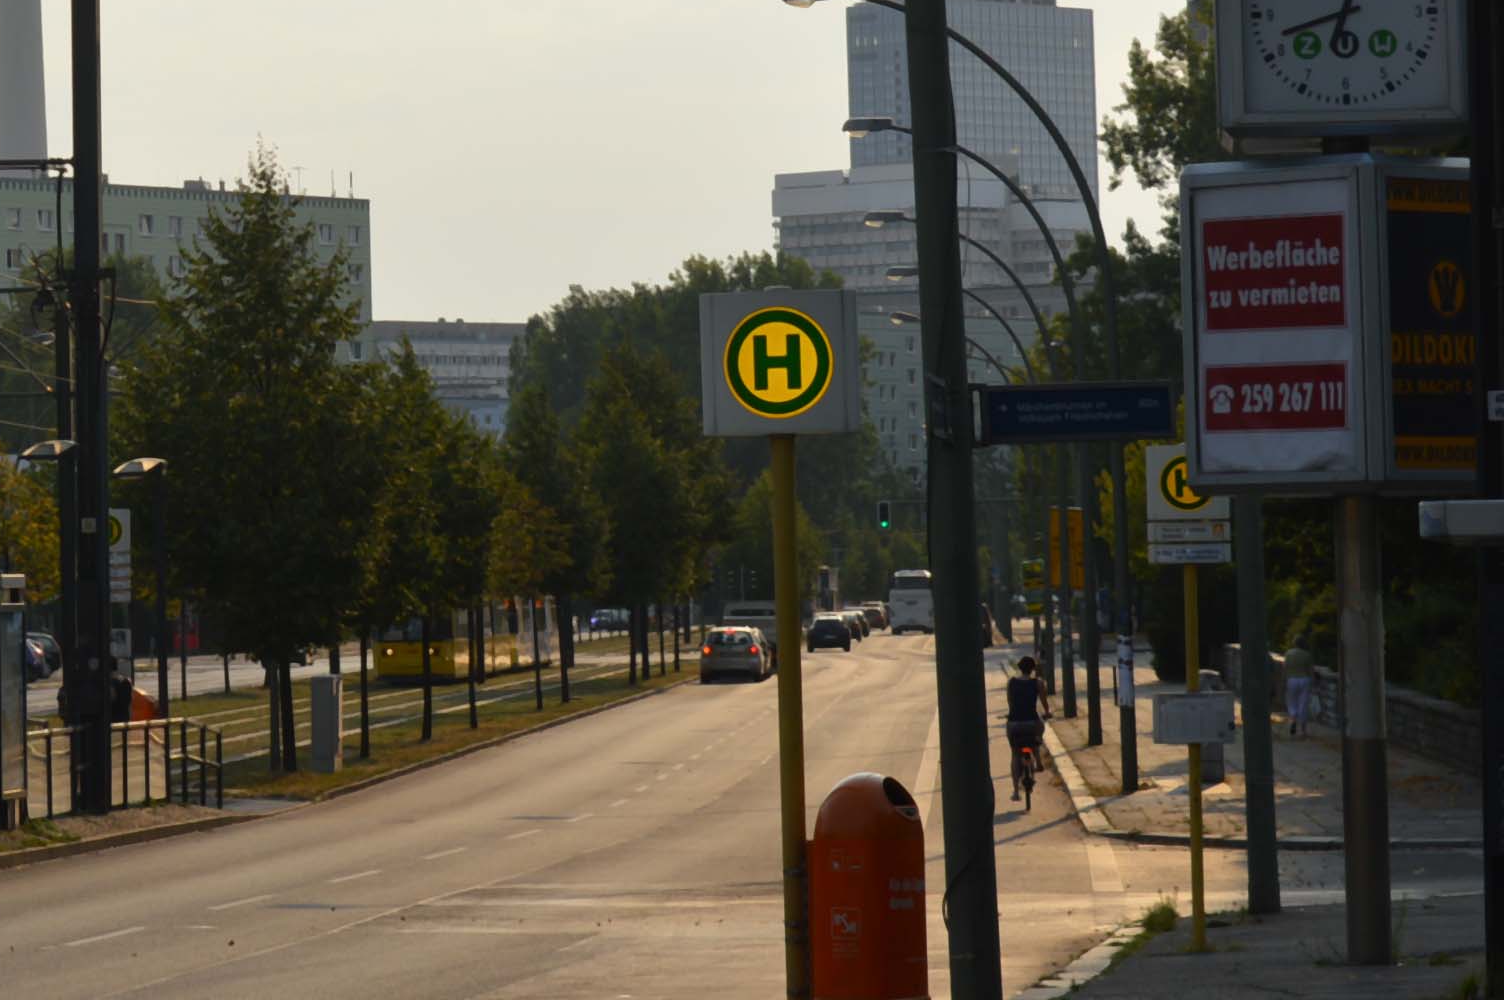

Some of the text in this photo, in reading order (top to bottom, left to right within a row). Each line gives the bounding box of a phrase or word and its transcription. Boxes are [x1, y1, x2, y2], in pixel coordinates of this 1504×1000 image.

[1266, 9, 1274, 21] 9
[1415, 5, 1423, 18] 3
[1301, 35, 1316, 54] Z
[1373, 31, 1392, 52] W
[1405, 41, 1413, 52] 4
[1277, 43, 1285, 56] 8
[1304, 68, 1312, 80] 7
[1380, 67, 1388, 79] 5
[1342, 77, 1350, 90] 6
[1207, 239, 1340, 271] Werbefläche
[1209, 279, 1342, 310] zu vermieten
[753, 334, 802, 391] H
[1241, 380, 1344, 414] 259 267 111
